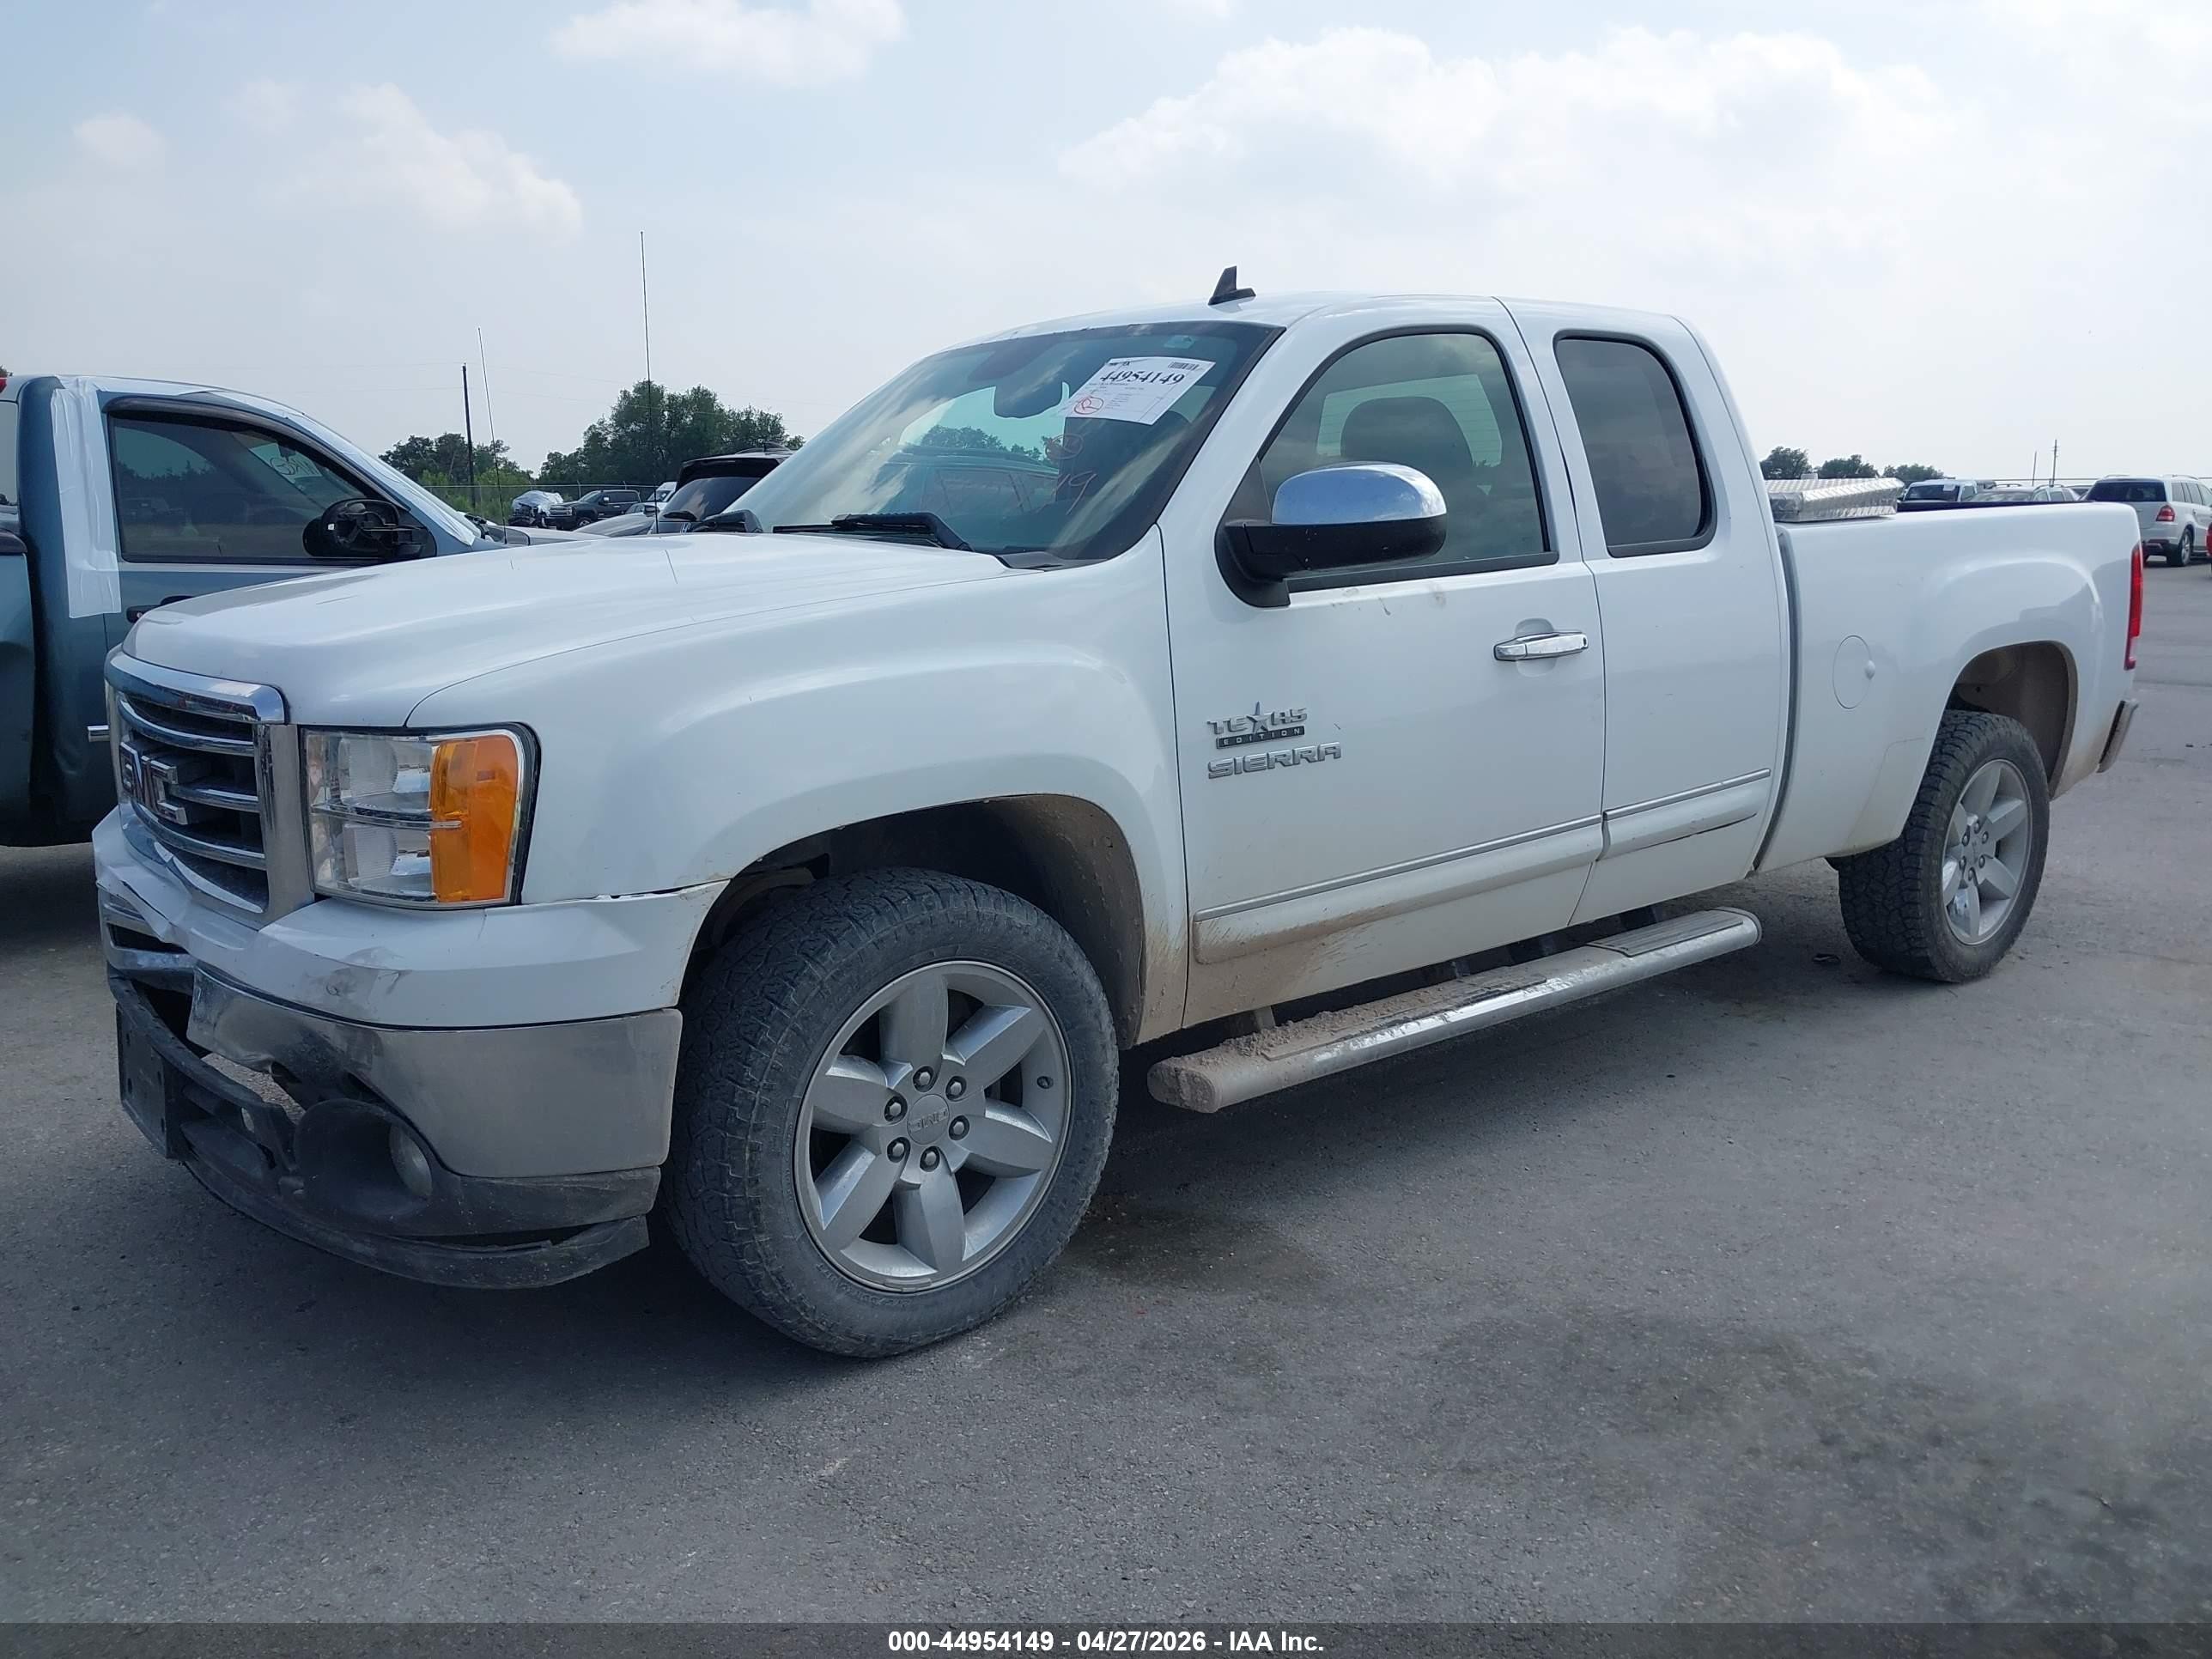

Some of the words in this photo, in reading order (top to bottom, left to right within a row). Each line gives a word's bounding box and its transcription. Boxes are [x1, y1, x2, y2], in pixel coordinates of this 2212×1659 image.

[1100, 371, 1184, 386] 44954149
[1206, 702, 1308, 735] TEXAS
[1222, 727, 1302, 746] EDITION
[1207, 742, 1342, 780] SIERRA
